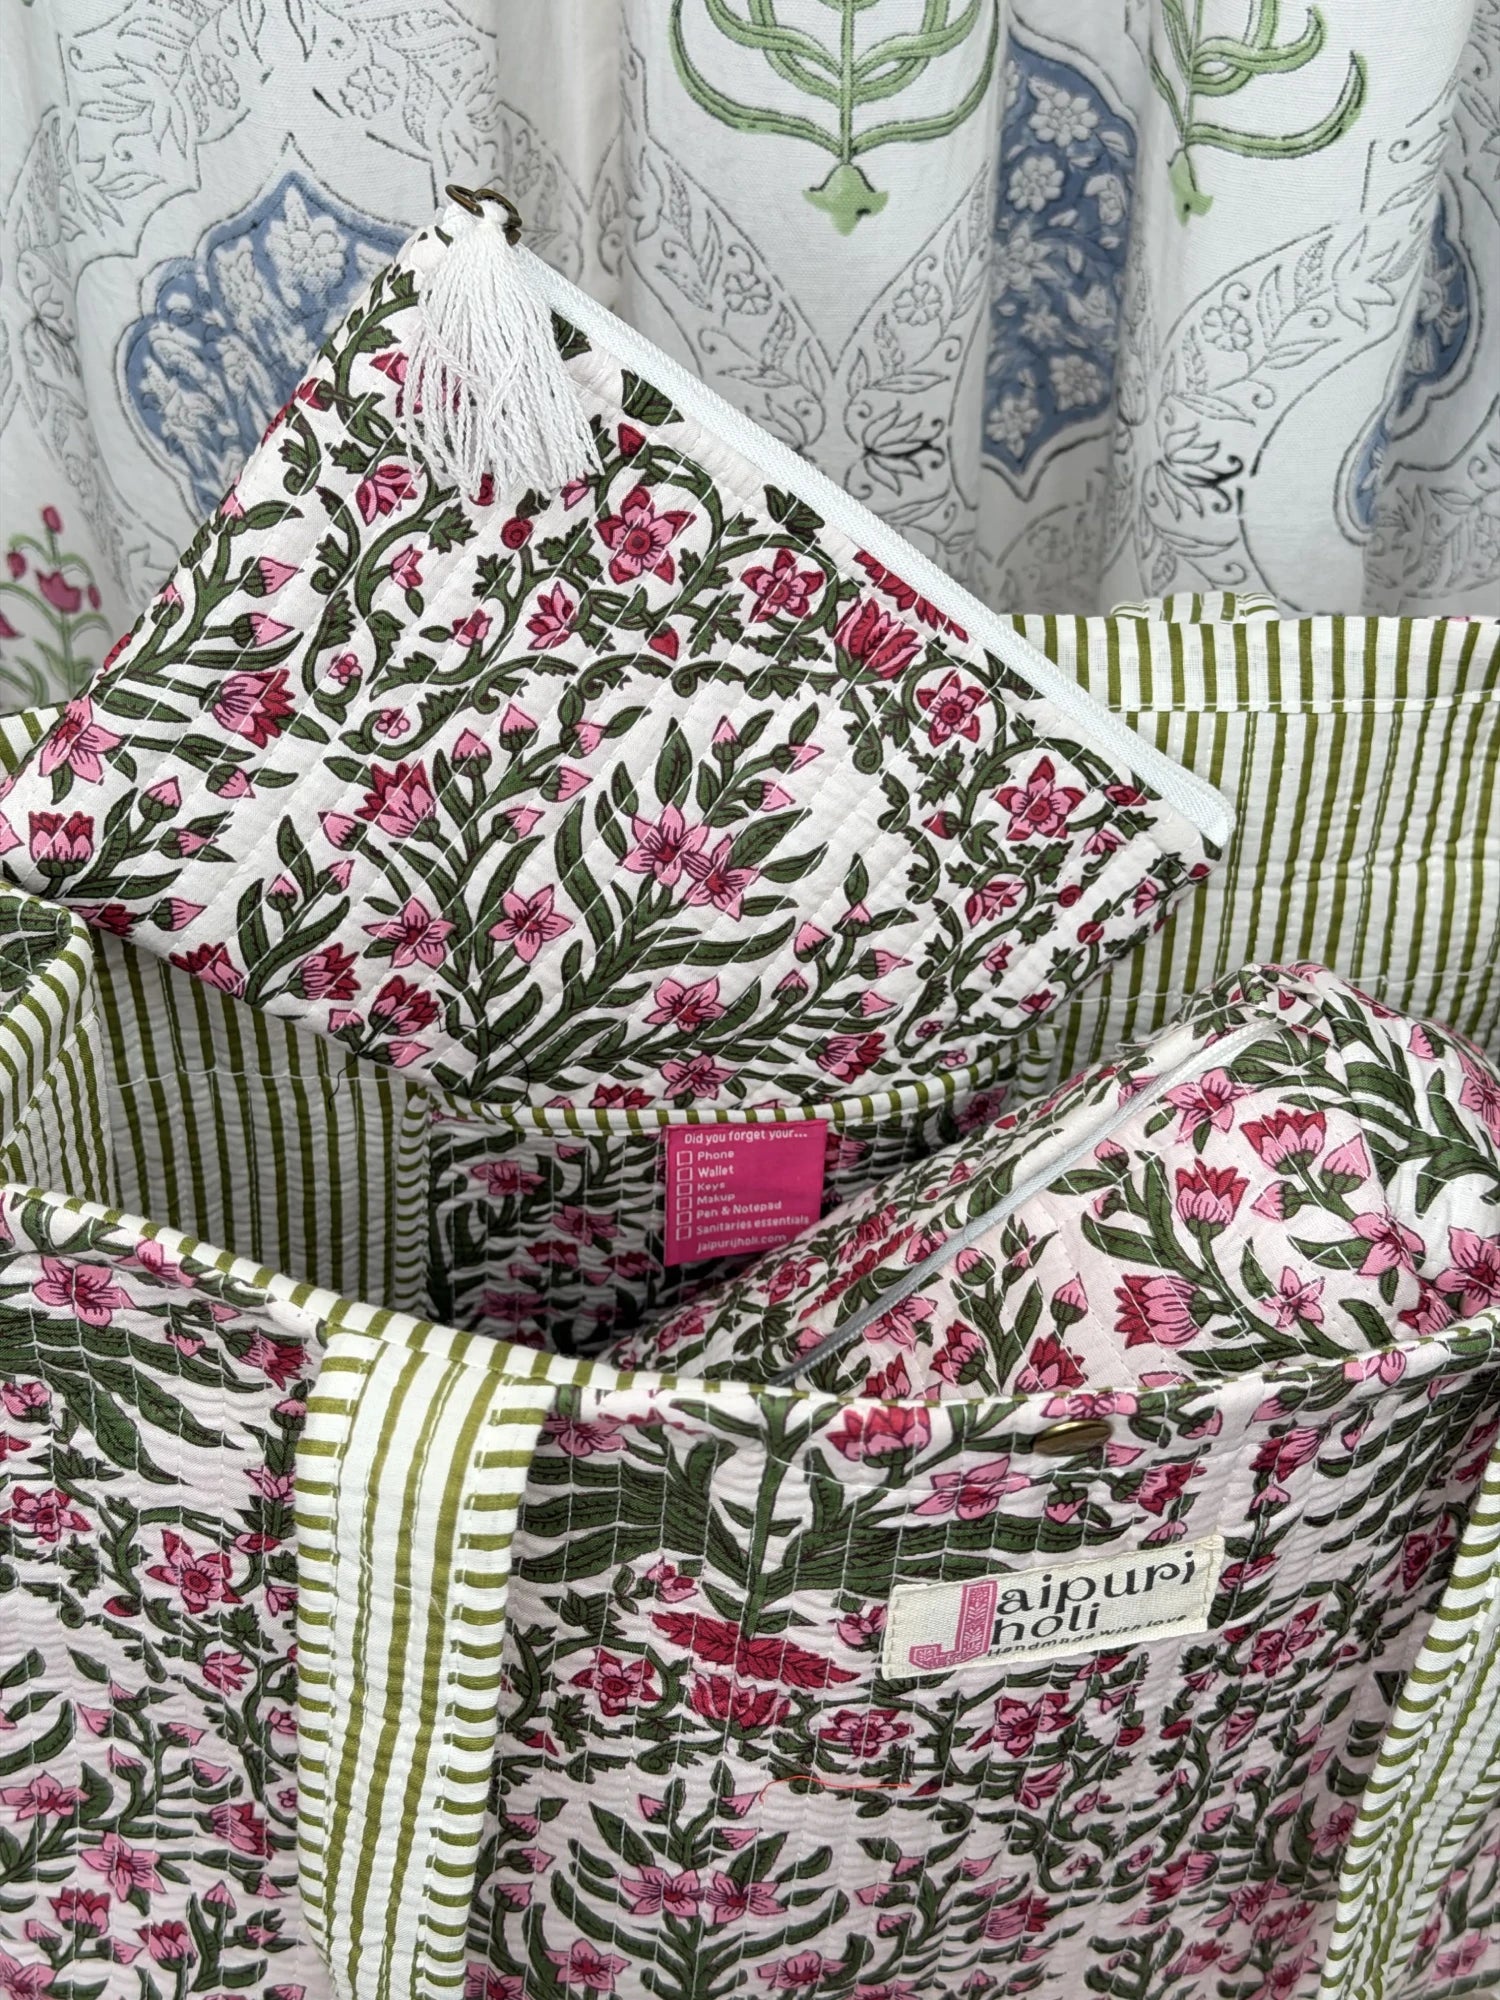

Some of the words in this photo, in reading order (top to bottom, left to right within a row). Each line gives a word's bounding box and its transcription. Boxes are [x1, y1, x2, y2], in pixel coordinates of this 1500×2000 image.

[684, 1133, 704, 1145] Did
[705, 1133, 726, 1146] you
[728, 1130, 766, 1143] forget
[768, 1129, 808, 1141] your...
[697, 1150, 735, 1162] Phone
[697, 1165, 735, 1178] Wallet
[697, 1182, 726, 1193] Keys
[696, 1193, 736, 1205] Makup
[696, 1208, 718, 1220] Pen
[721, 1206, 731, 1216] &
[732, 1201, 783, 1215] Notepad
[696, 1219, 752, 1236] Sanitaries
[754, 1215, 810, 1229] essentials
[1099, 1623, 1142, 1637] with
[1145, 1613, 1188, 1628] love
